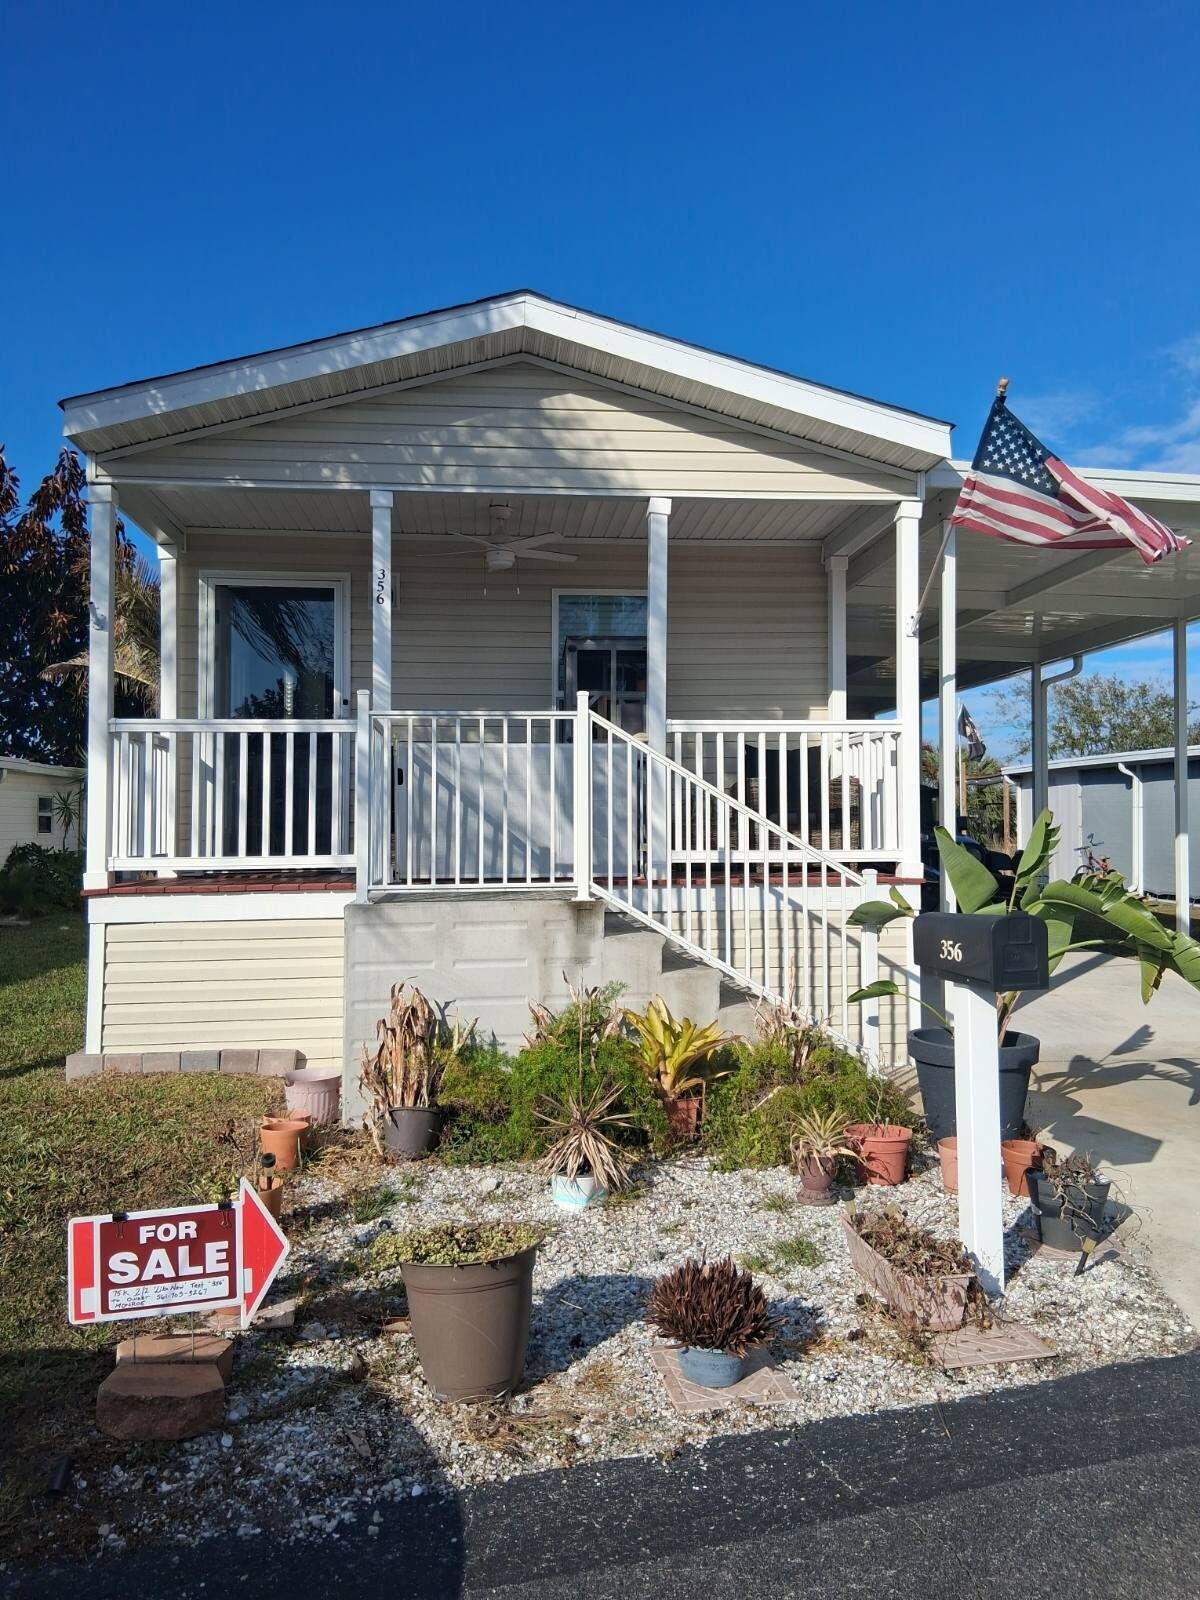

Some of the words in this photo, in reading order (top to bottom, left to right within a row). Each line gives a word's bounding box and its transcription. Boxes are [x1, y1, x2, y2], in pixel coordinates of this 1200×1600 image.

[376, 568, 386, 605] 356
[939, 939, 963, 962] 356
[139, 1220, 198, 1245] FOR
[107, 1240, 229, 1284] SALE
